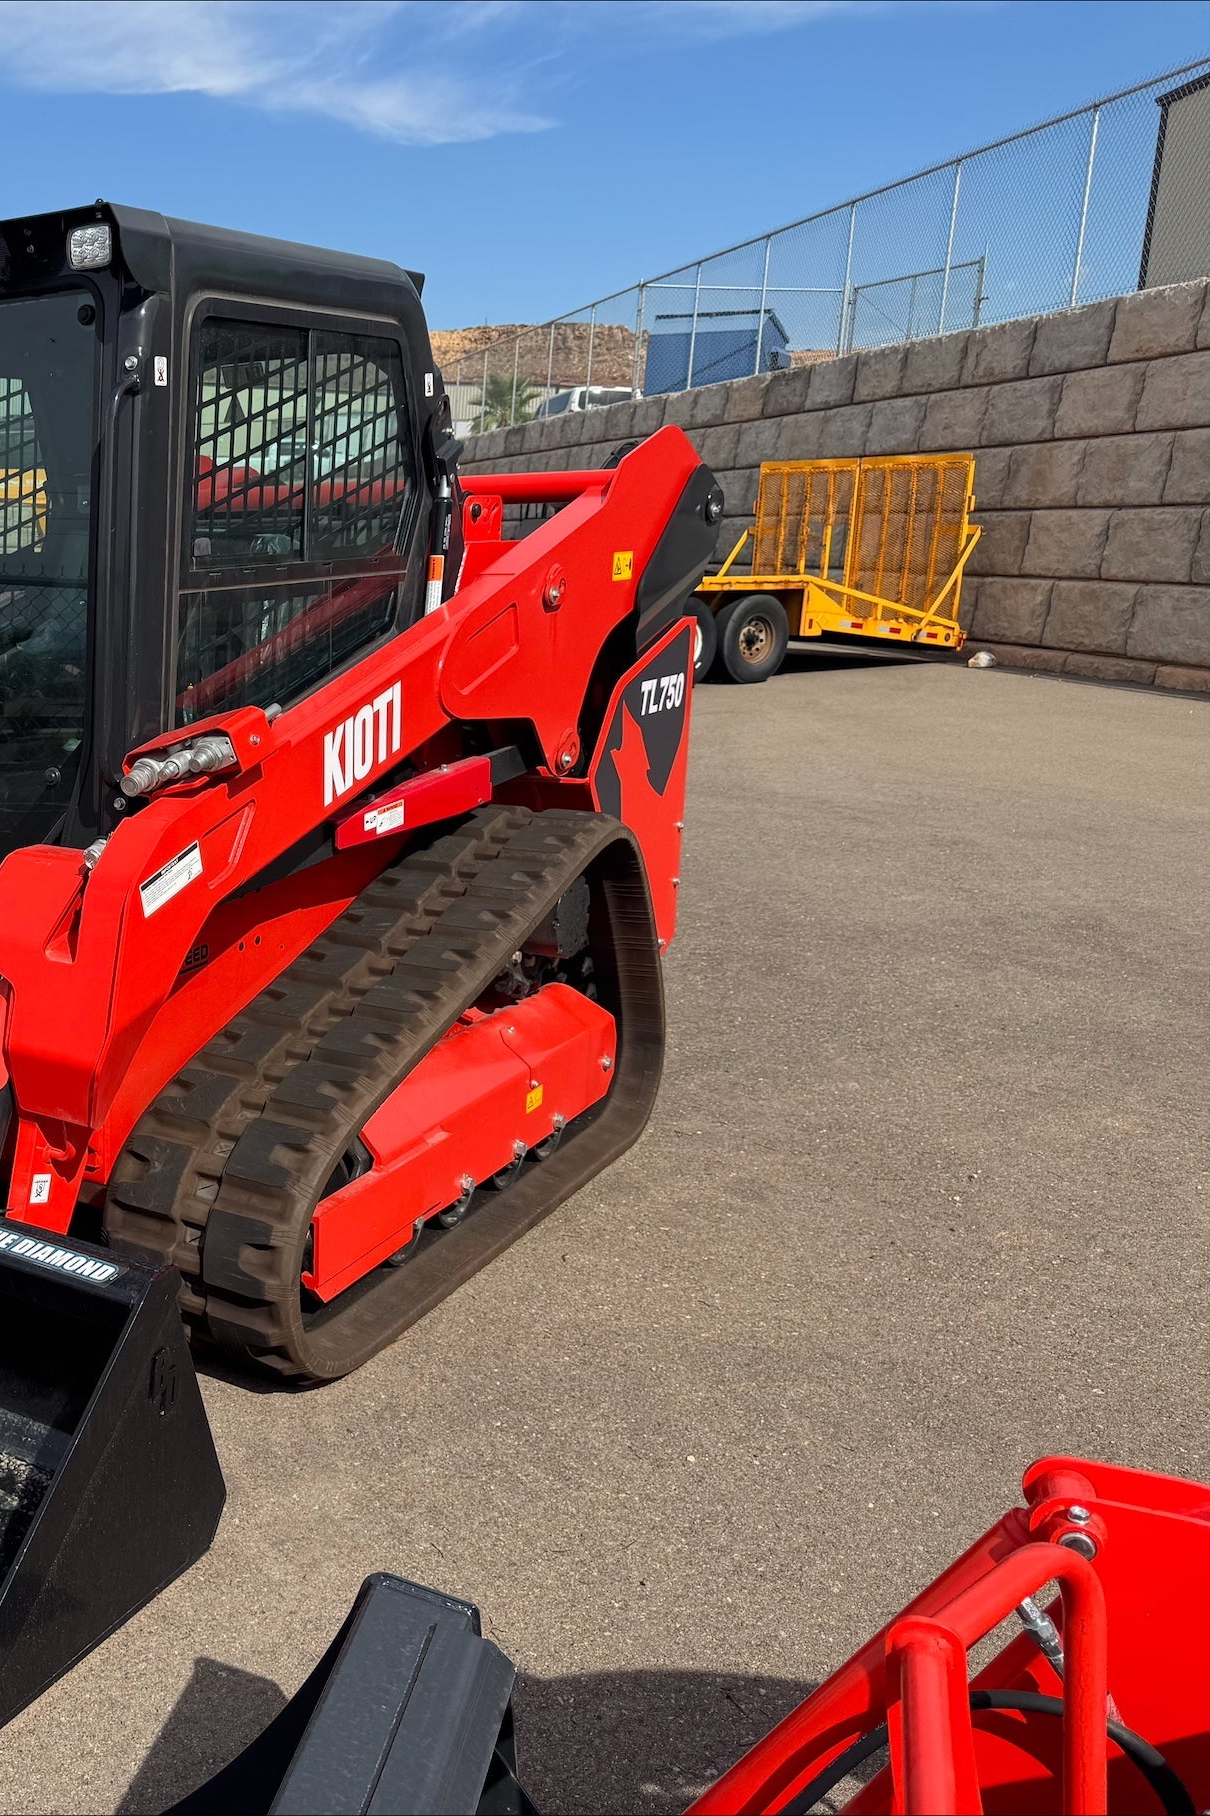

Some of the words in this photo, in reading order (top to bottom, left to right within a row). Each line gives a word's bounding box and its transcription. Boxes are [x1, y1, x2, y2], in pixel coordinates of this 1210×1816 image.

[641, 672, 685, 716] TL750
[324, 680, 402, 807] KIOTI
[10, 1238, 116, 1281] DIAMOND
